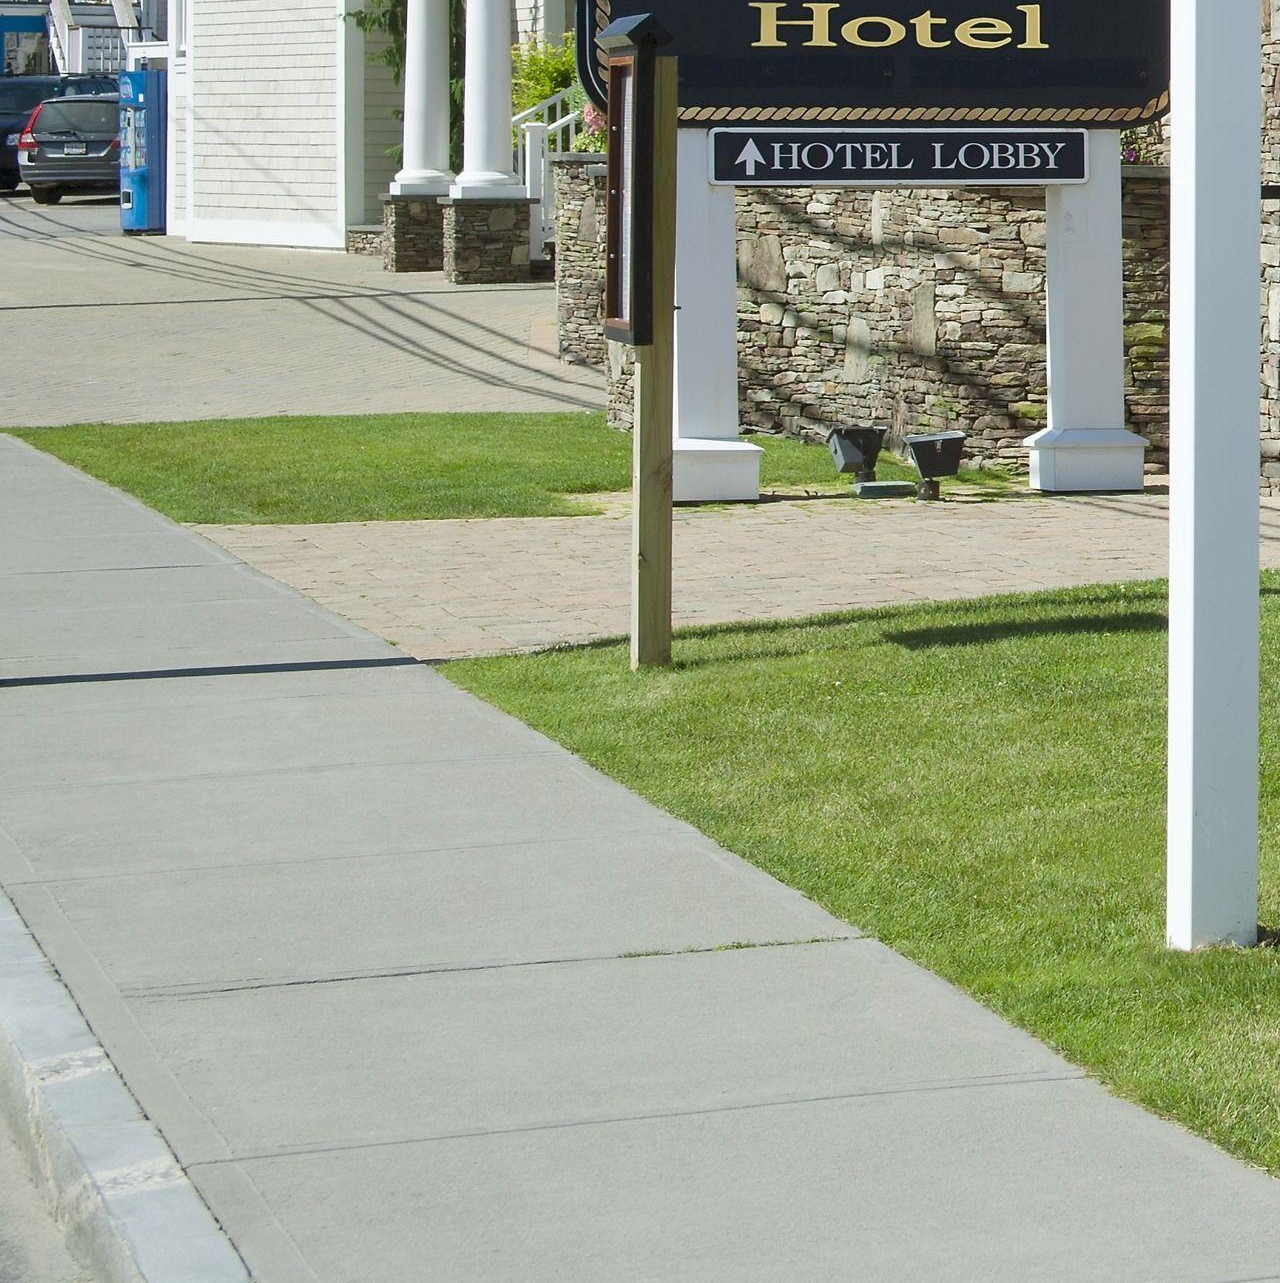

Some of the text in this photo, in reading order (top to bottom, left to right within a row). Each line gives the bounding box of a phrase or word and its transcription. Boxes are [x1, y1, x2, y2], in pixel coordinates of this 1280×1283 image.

[748, 2, 1050, 49] Hotel
[770, 142, 1067, 171] HOTEL LOBBY
